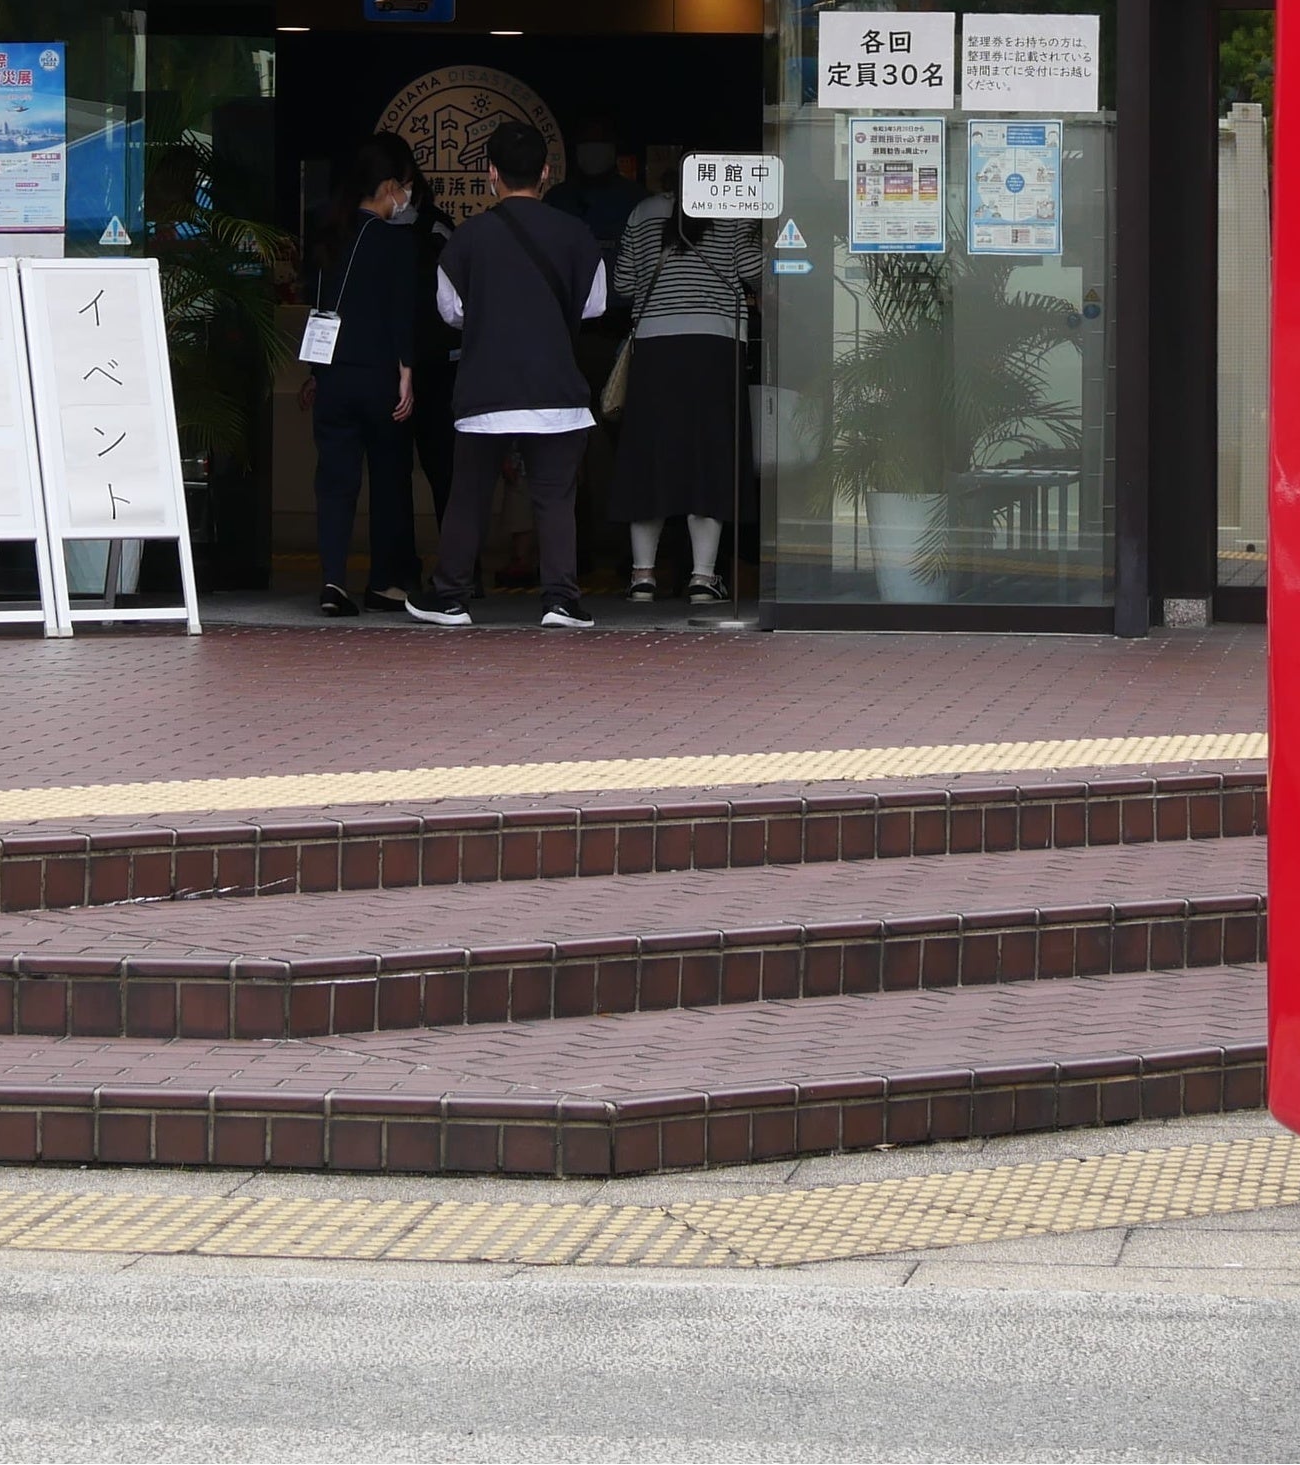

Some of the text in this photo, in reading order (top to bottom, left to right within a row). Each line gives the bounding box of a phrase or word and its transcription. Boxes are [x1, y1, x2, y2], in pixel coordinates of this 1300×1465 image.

[860, 29, 912, 54] 各回
[827, 61, 944, 88] 定員30名
[698, 163, 769, 182] 開館中
[427, 176, 488, 196] 横浜市
[710, 185, 757, 196] OPEN
[78, 289, 131, 520] イベント
